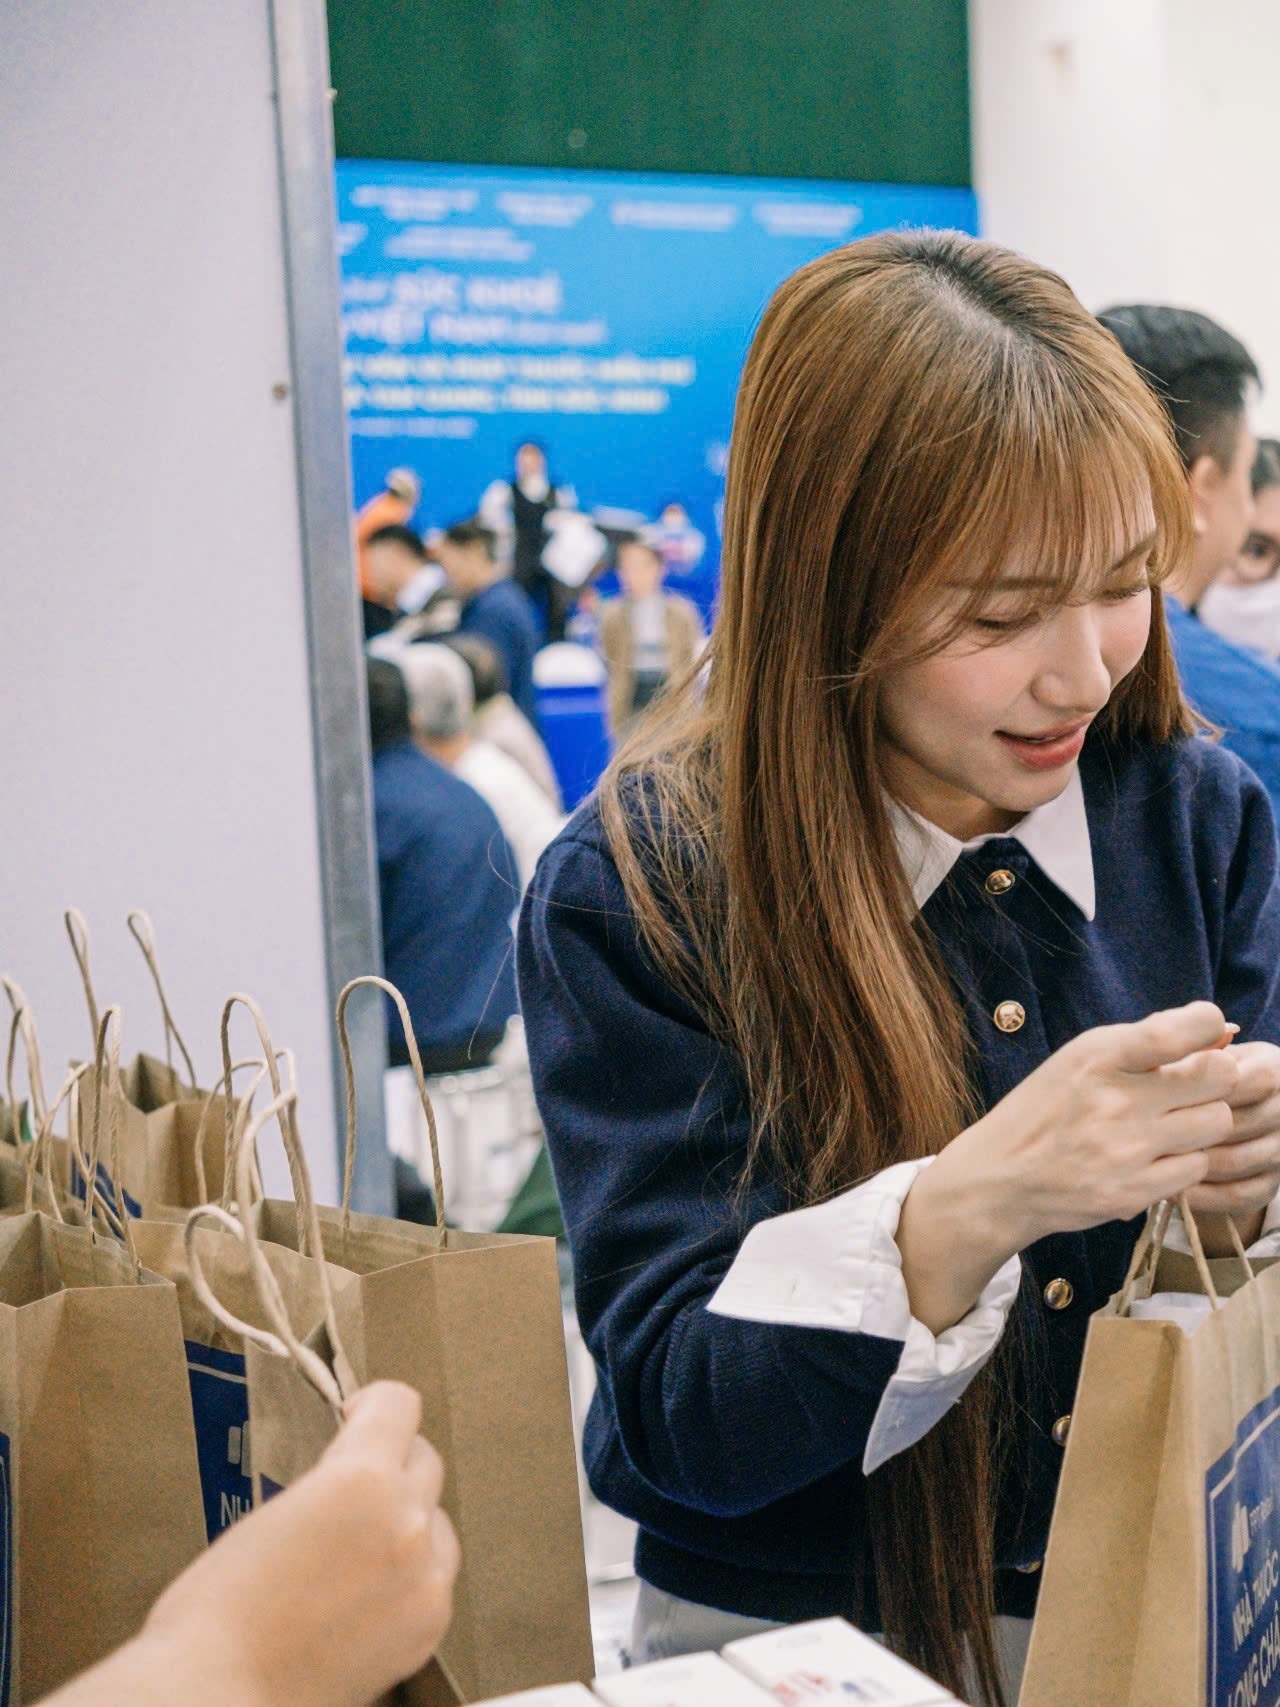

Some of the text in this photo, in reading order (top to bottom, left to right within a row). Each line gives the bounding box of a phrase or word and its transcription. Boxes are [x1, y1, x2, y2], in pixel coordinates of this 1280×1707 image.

[220, 1490, 250, 1527] NH
[1232, 1582, 1254, 1650] NHÀ
[1228, 1653, 1259, 1707] ONG
